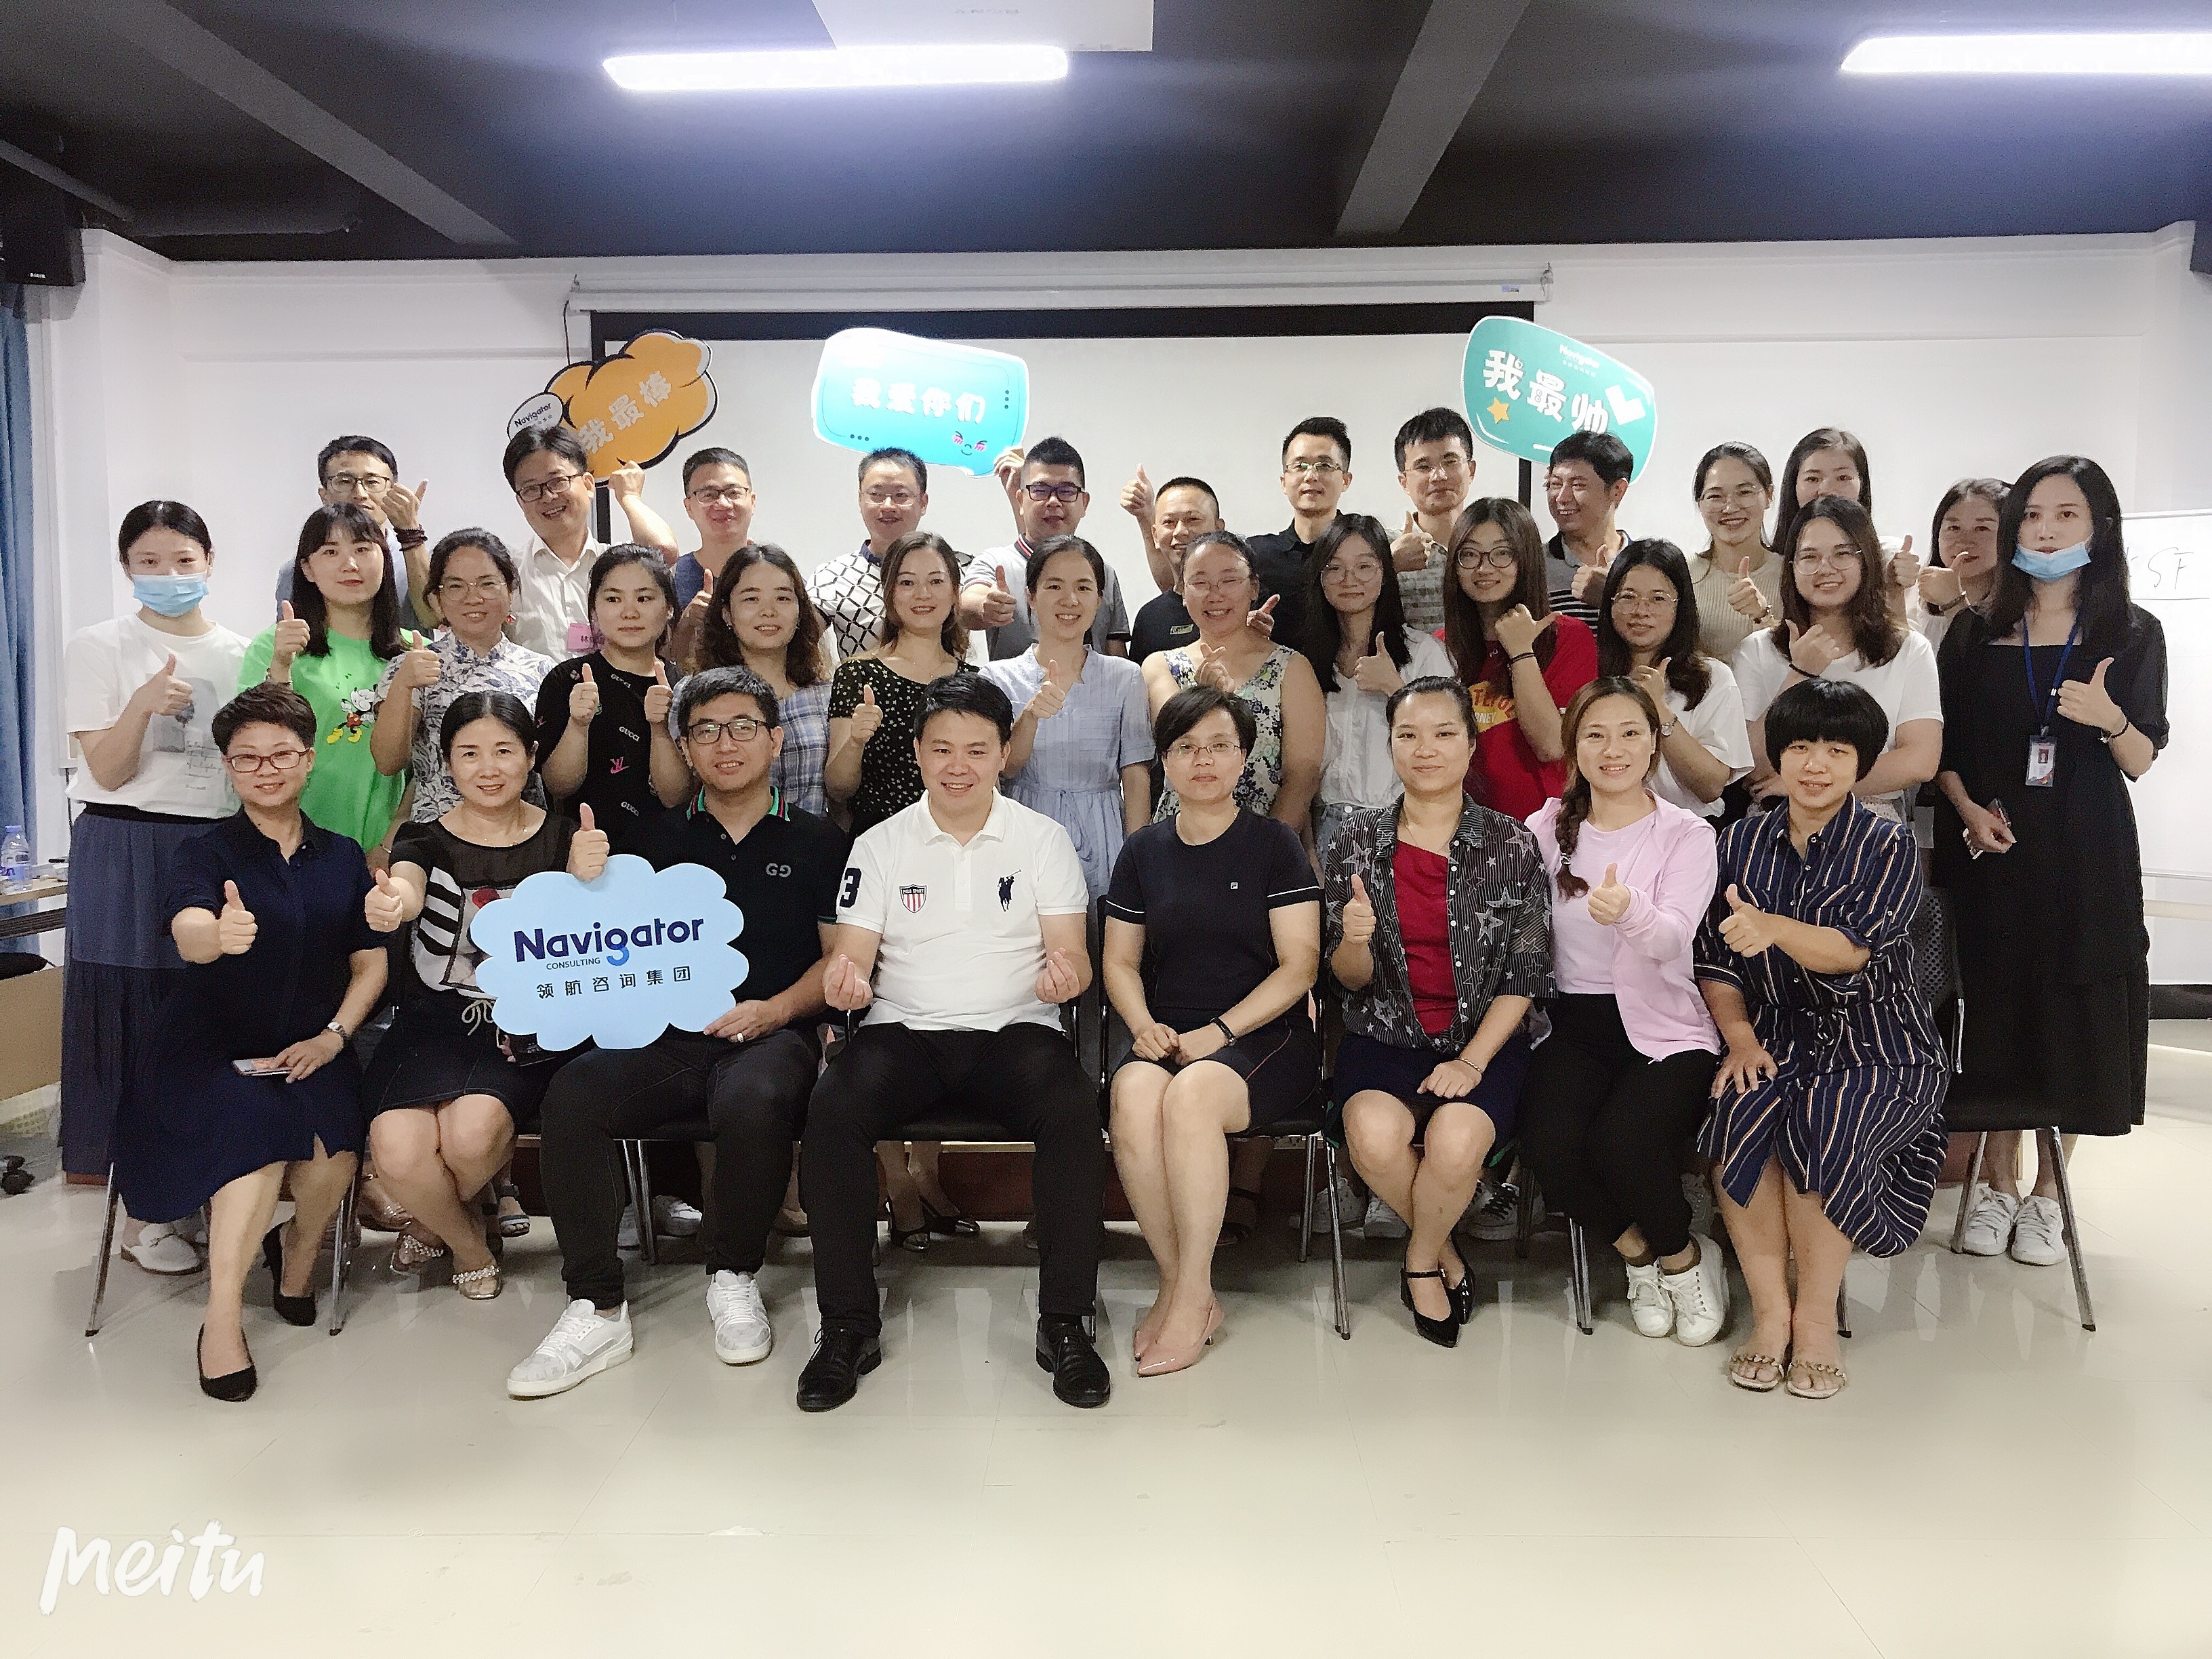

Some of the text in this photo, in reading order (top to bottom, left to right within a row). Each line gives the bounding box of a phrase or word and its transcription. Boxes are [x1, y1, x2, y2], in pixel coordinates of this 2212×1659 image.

[578, 371, 672, 453] 我最棒
[1483, 350, 1610, 434] 我最帅
[514, 403, 551, 427] Navigator
[839, 867, 862, 908] 3
[514, 918, 704, 966] Navigator
[537, 966, 691, 999] 领航咨询集团
[546, 957, 601, 970] CONSULTING
